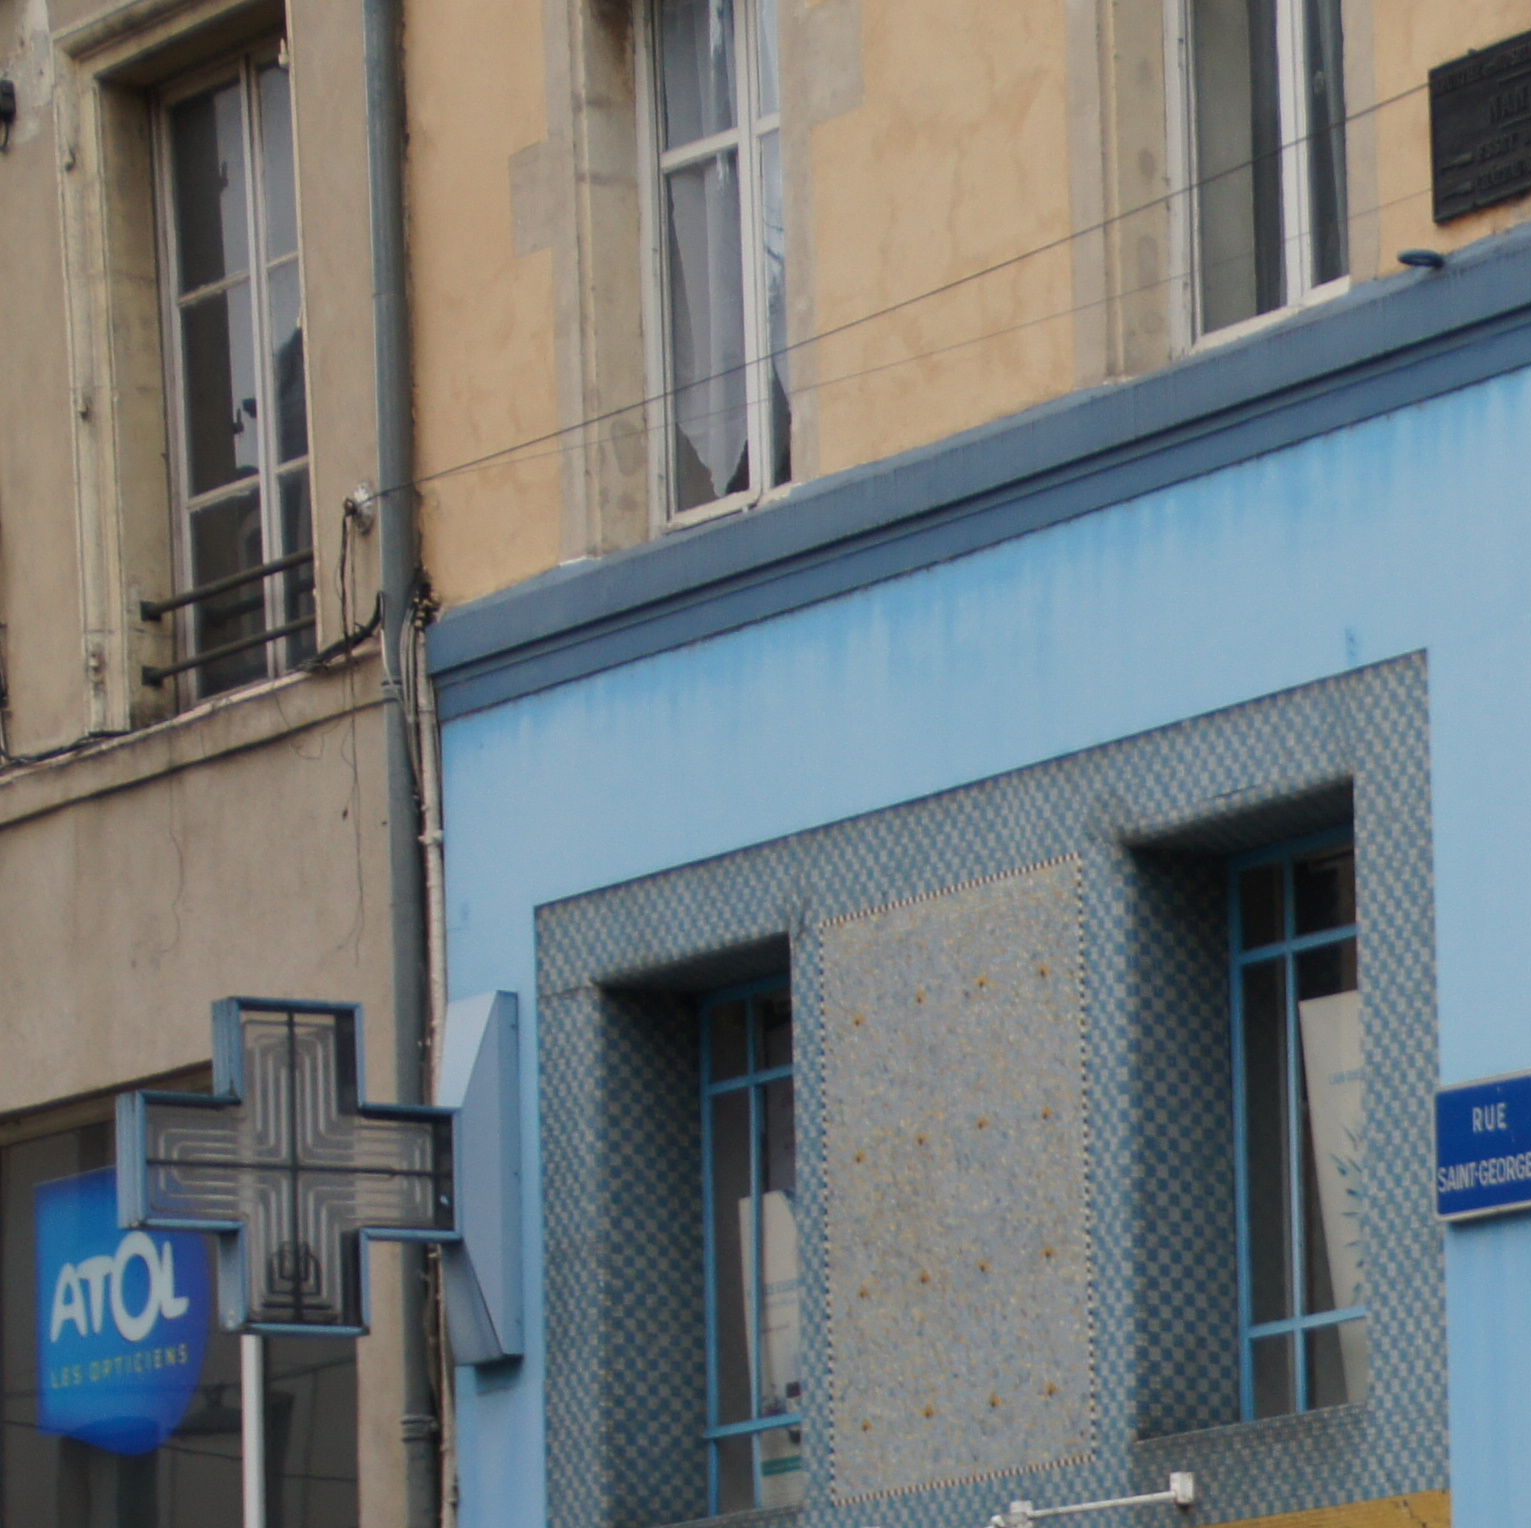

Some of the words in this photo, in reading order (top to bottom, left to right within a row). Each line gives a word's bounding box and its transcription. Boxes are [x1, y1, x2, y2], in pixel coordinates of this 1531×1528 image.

[1472, 1103, 1507, 1132] RUE
[50, 1231, 190, 1343] ATOL
[52, 1364, 82, 1388] LES
[90, 1343, 190, 1381] OPTICIENS
